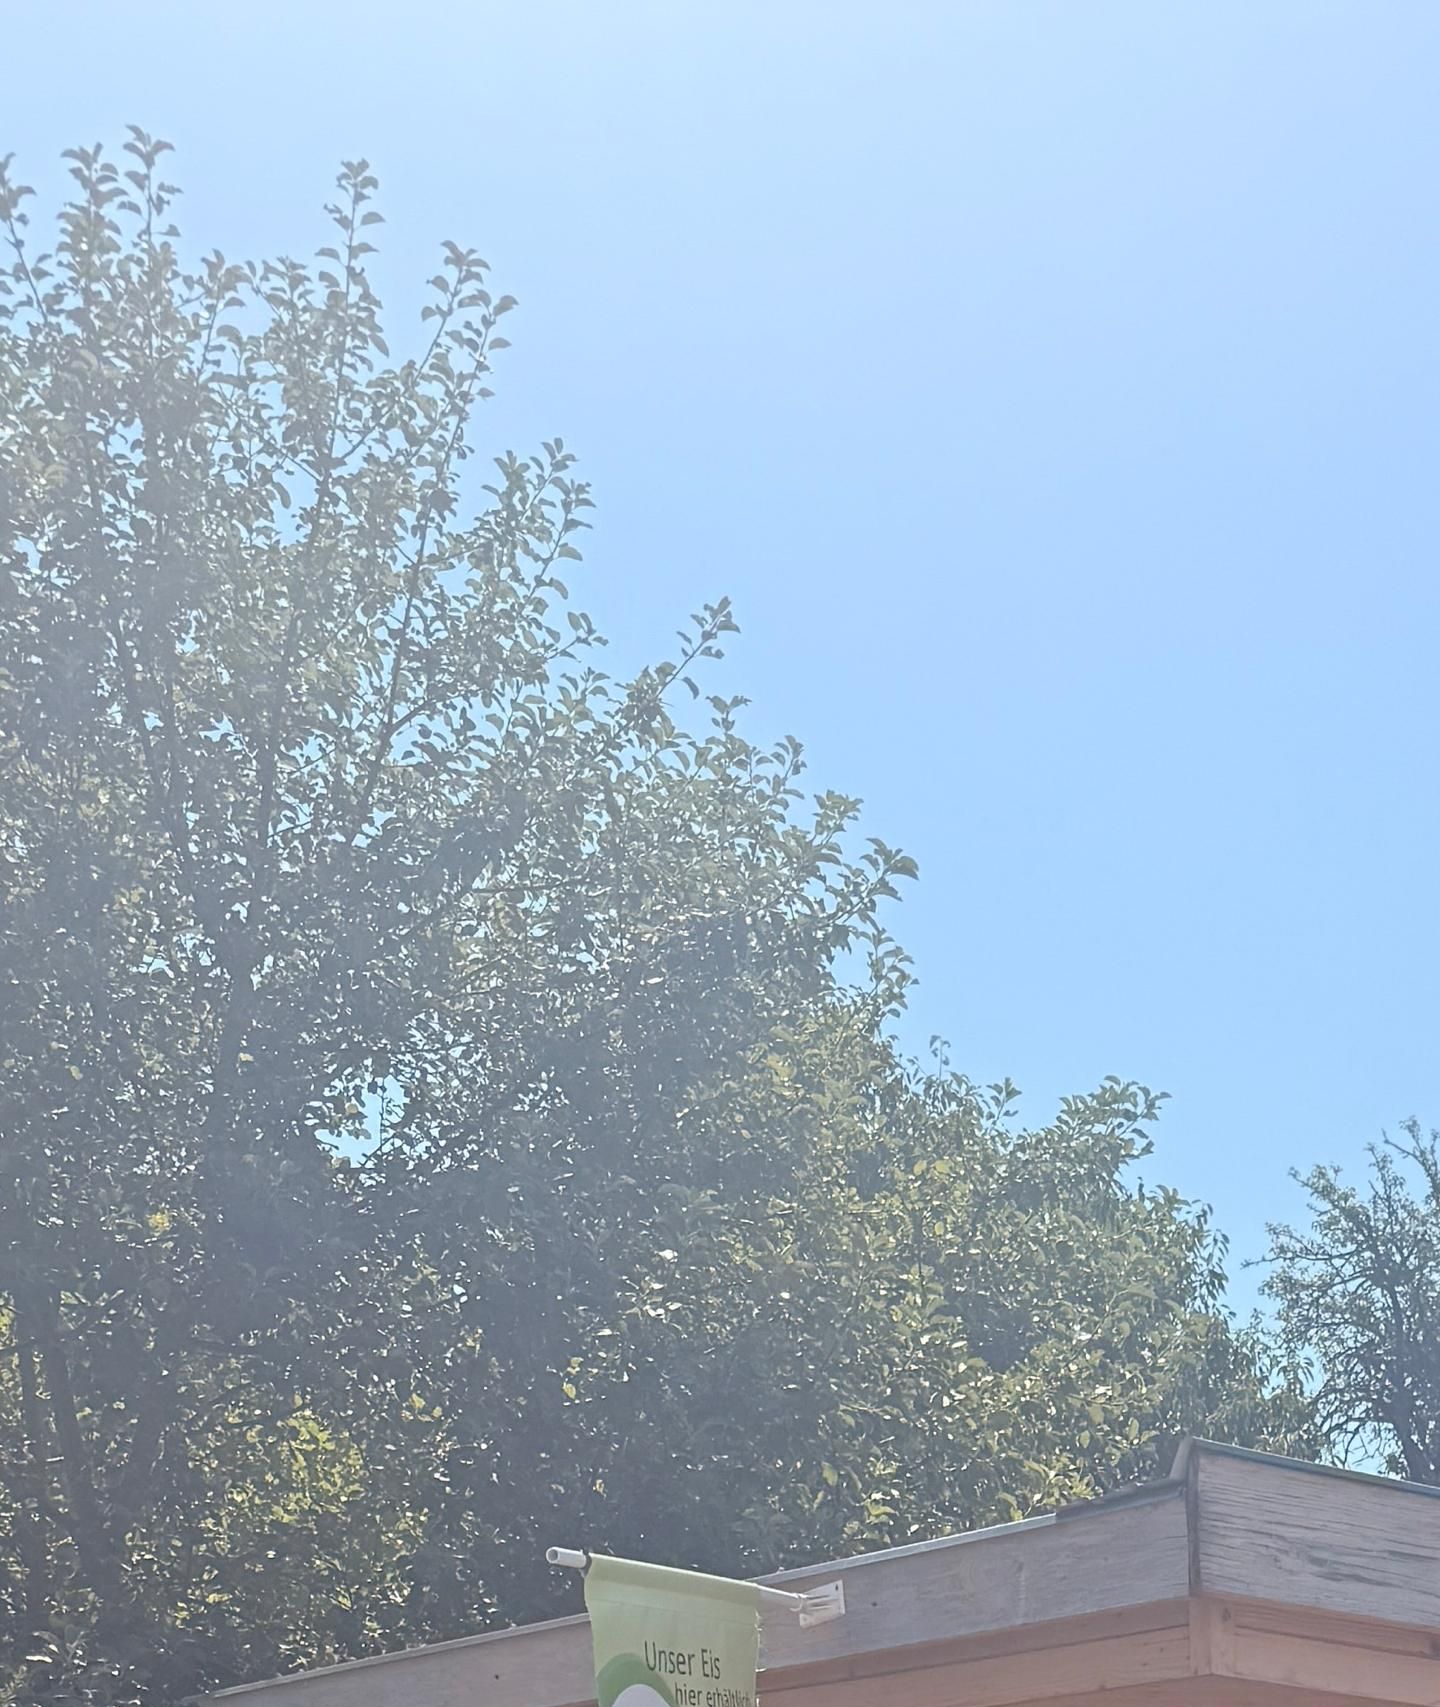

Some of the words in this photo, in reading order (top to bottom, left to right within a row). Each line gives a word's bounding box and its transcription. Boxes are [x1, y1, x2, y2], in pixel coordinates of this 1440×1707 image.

[644, 1639, 695, 1677] Unser
[701, 1647, 721, 1680] Eis
[674, 1680, 703, 1706] hier
